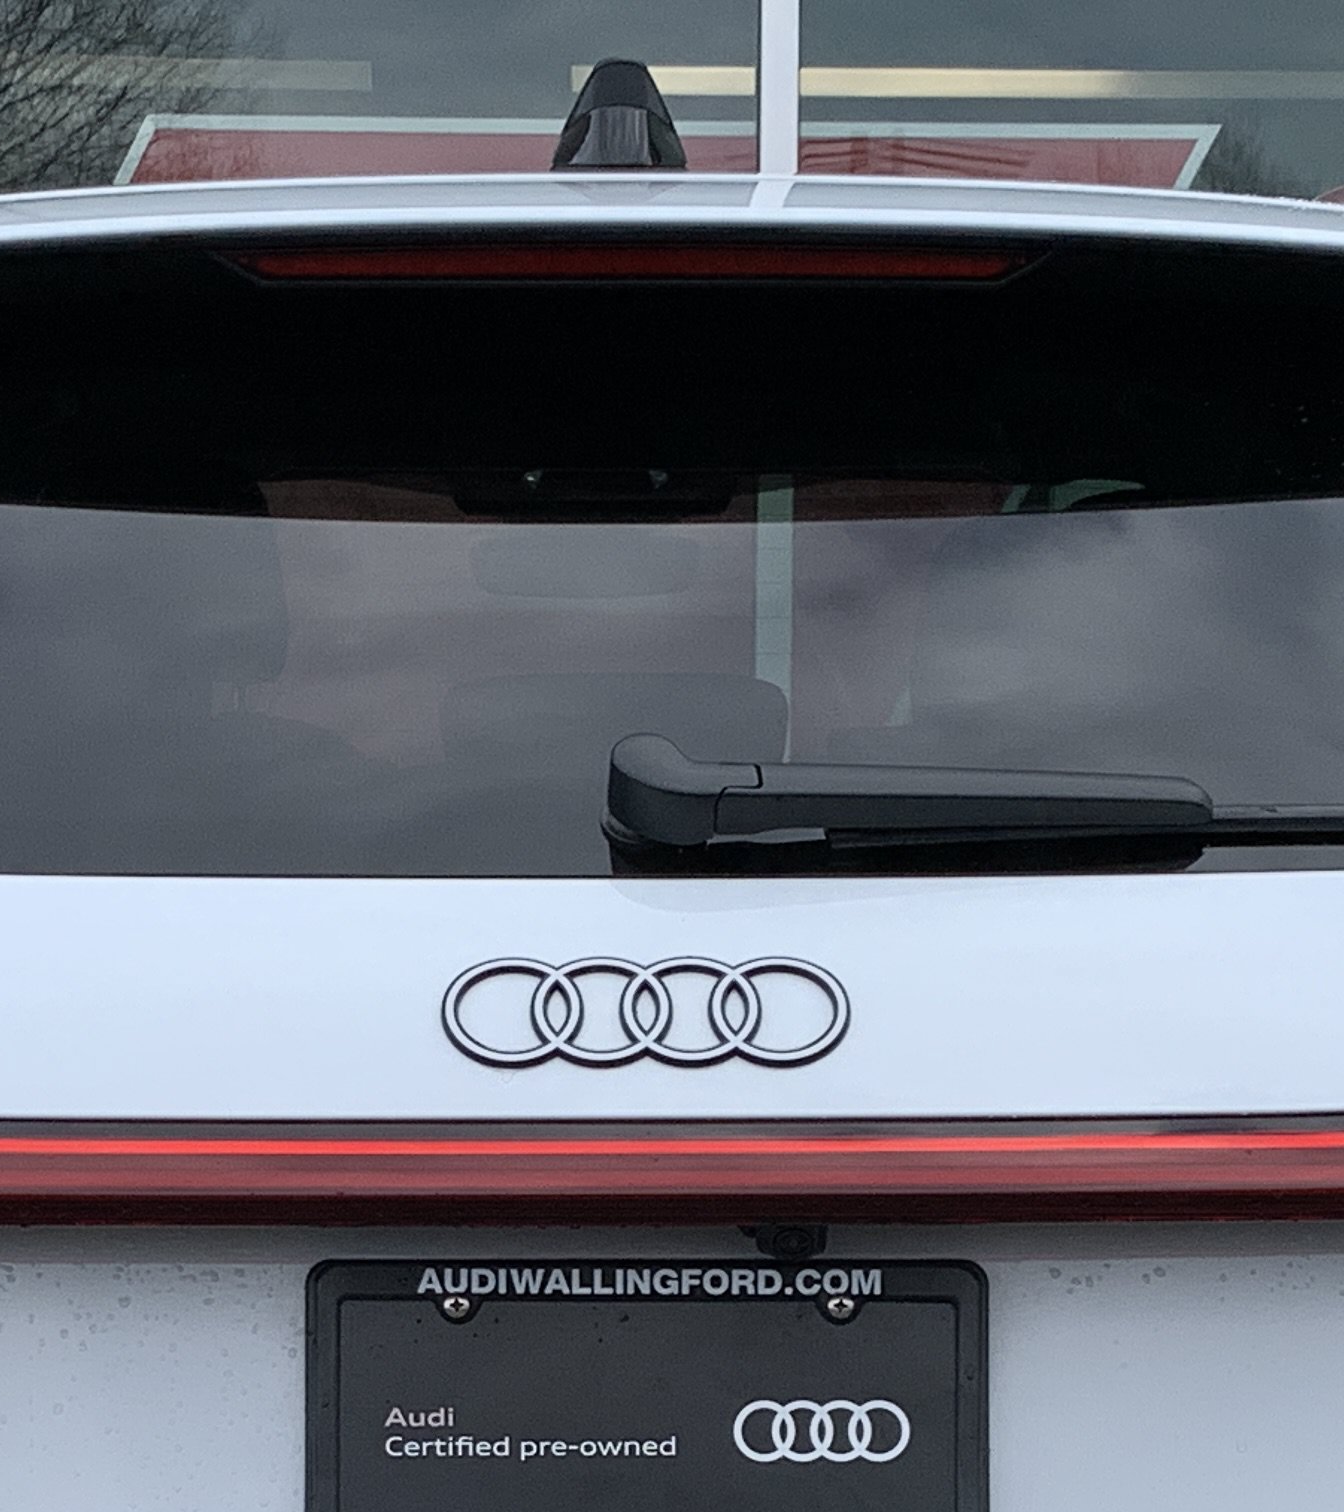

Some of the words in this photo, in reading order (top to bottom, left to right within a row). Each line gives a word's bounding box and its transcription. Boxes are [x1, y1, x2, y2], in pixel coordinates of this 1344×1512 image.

[416, 1267, 883, 1296] AUDIWALLINGFORD.COM
[384, 1406, 455, 1428] Audi
[384, 1435, 511, 1458] Certified
[519, 1435, 677, 1462] pre-owned
